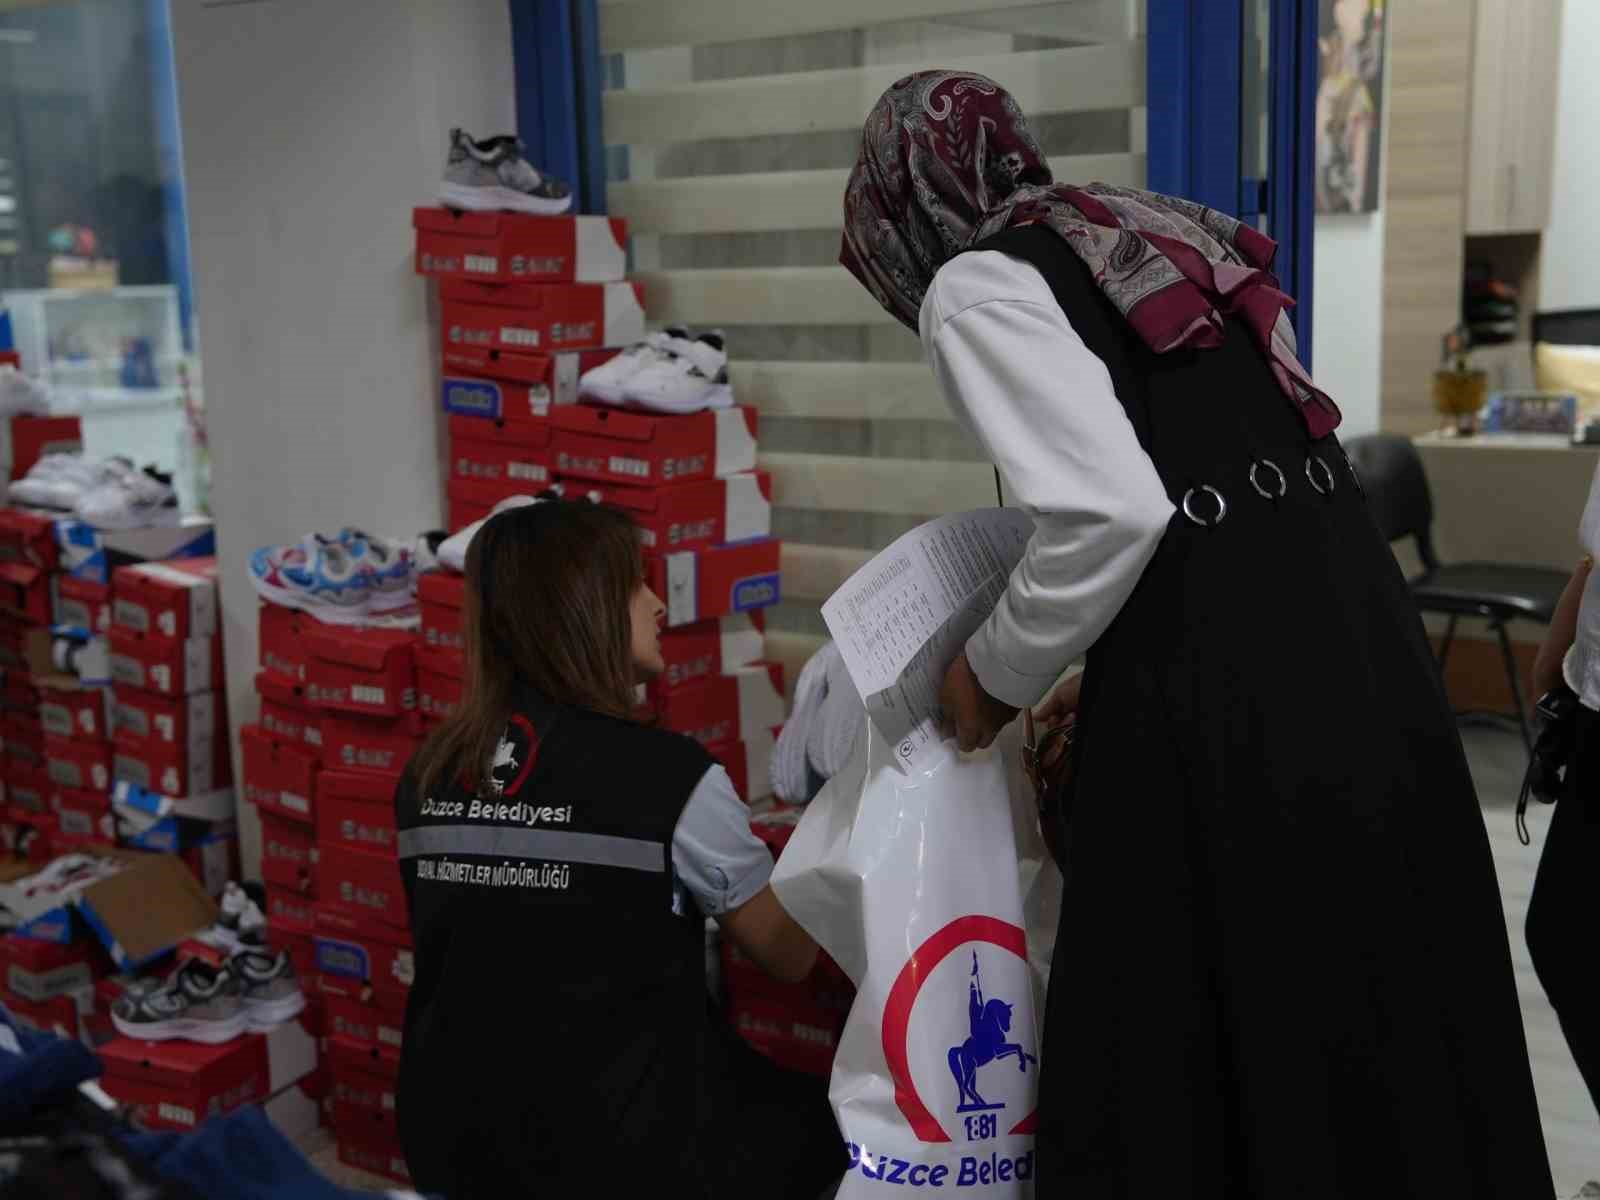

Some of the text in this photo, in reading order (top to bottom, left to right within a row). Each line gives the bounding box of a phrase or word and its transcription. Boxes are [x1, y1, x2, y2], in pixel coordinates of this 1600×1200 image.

[467, 800, 572, 825] Belediyesi
[437, 857, 493, 886] HİZMETLER
[494, 861, 570, 889] MÜDÜRLÜĞÜ
